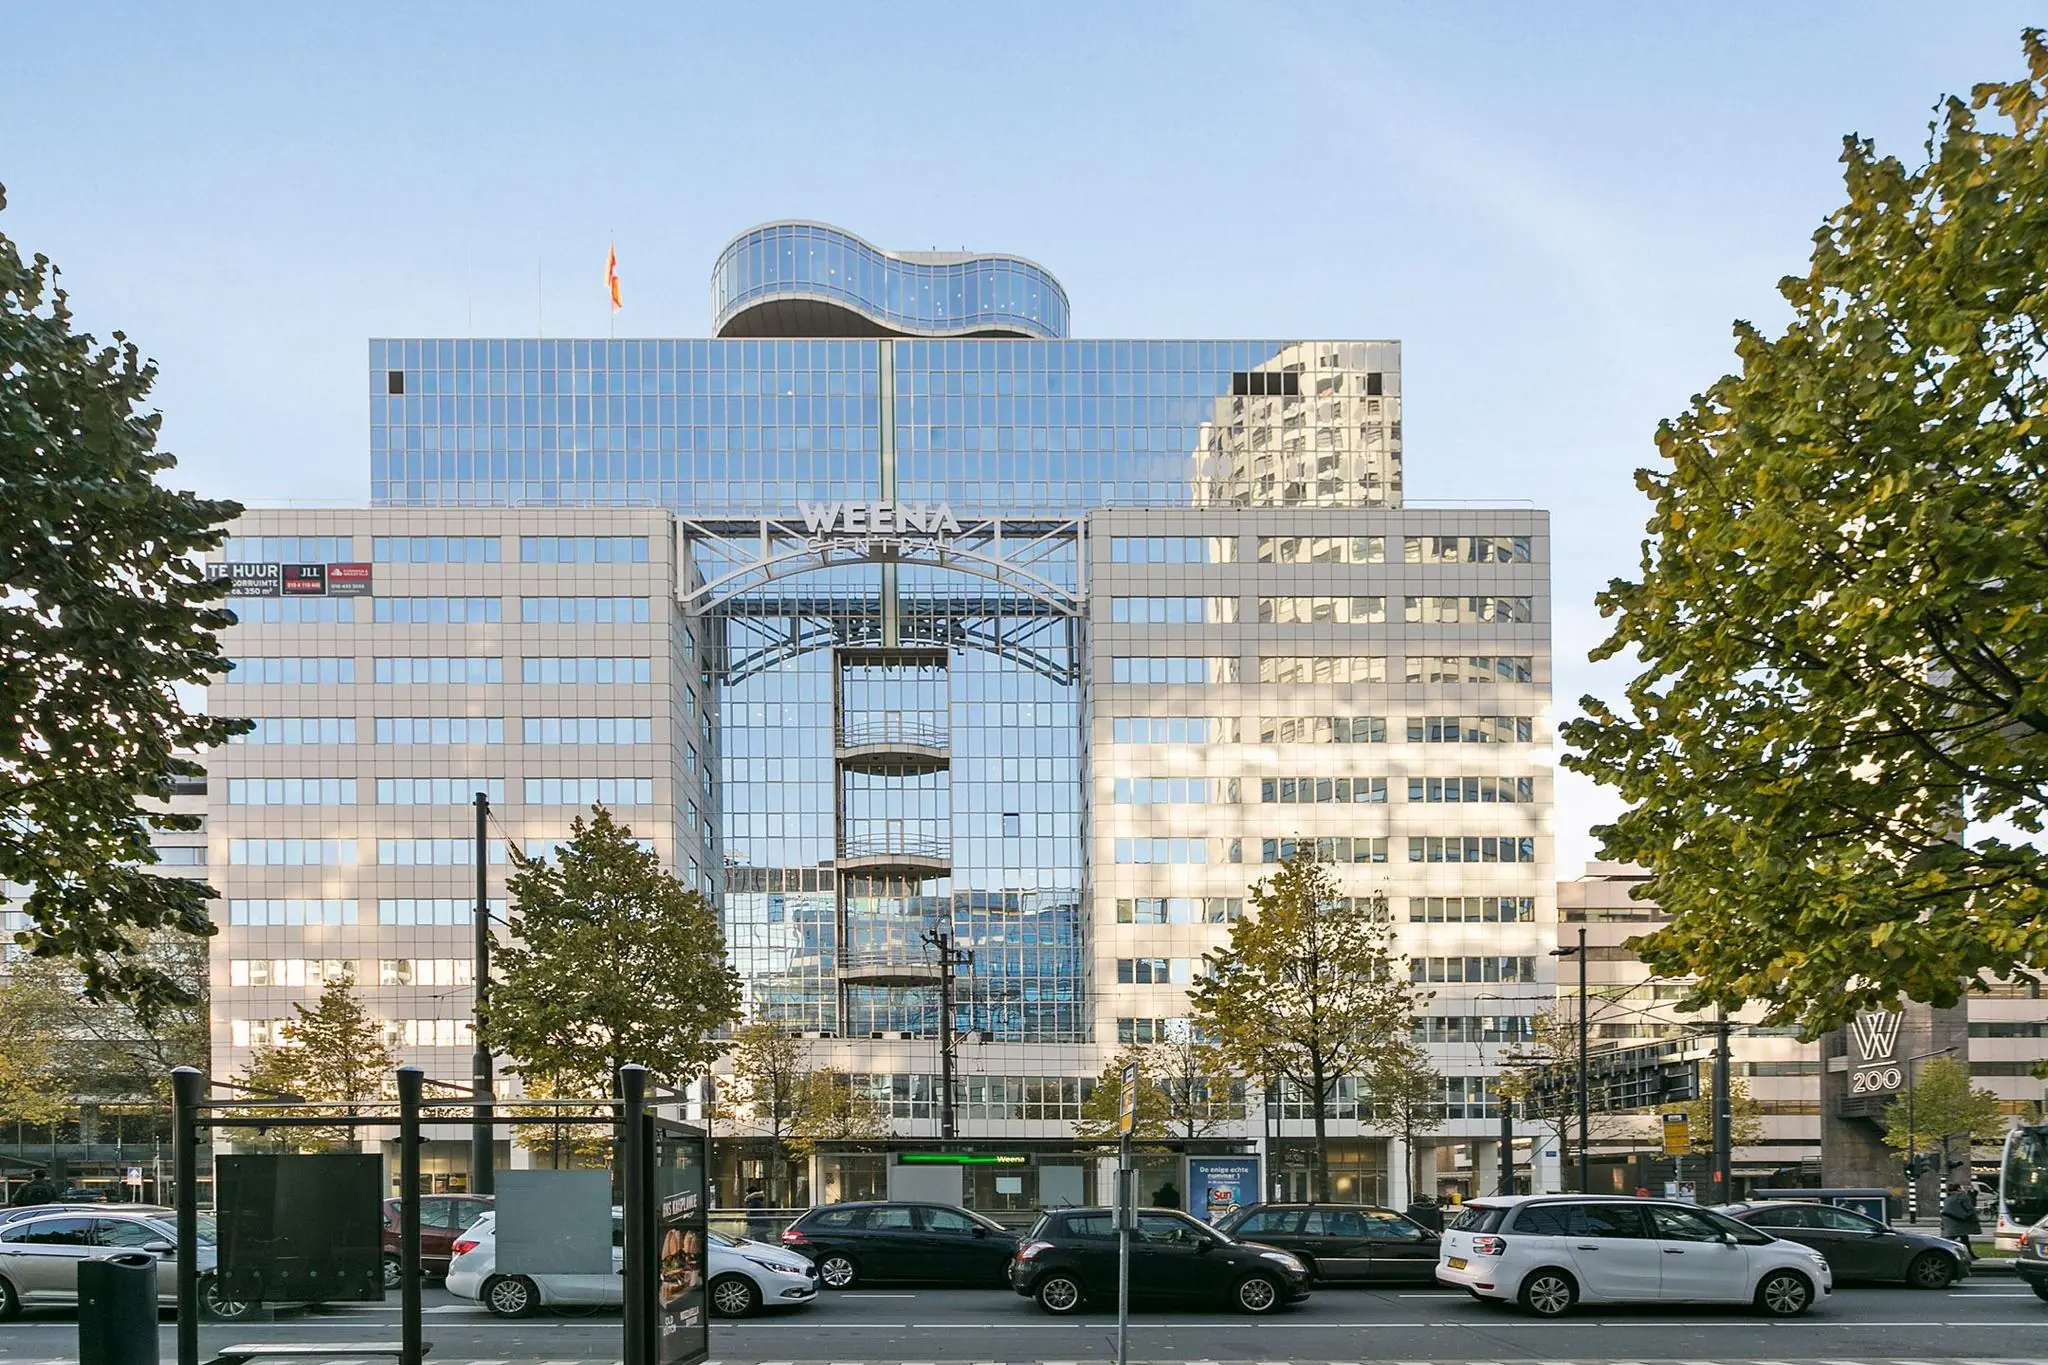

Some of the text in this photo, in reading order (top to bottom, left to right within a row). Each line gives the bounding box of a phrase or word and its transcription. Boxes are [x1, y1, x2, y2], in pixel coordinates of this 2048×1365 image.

[800, 500, 962, 533] WEENA
[807, 537, 957, 556] CENTRAL
[208, 565, 278, 578] TE HUUR
[300, 567, 320, 577] JLL
[1853, 1068, 1902, 1093] 200
[996, 1155, 1025, 1163] Weena
[1210, 1166, 1229, 1174] enige
[1213, 1190, 1232, 1201] Sun
